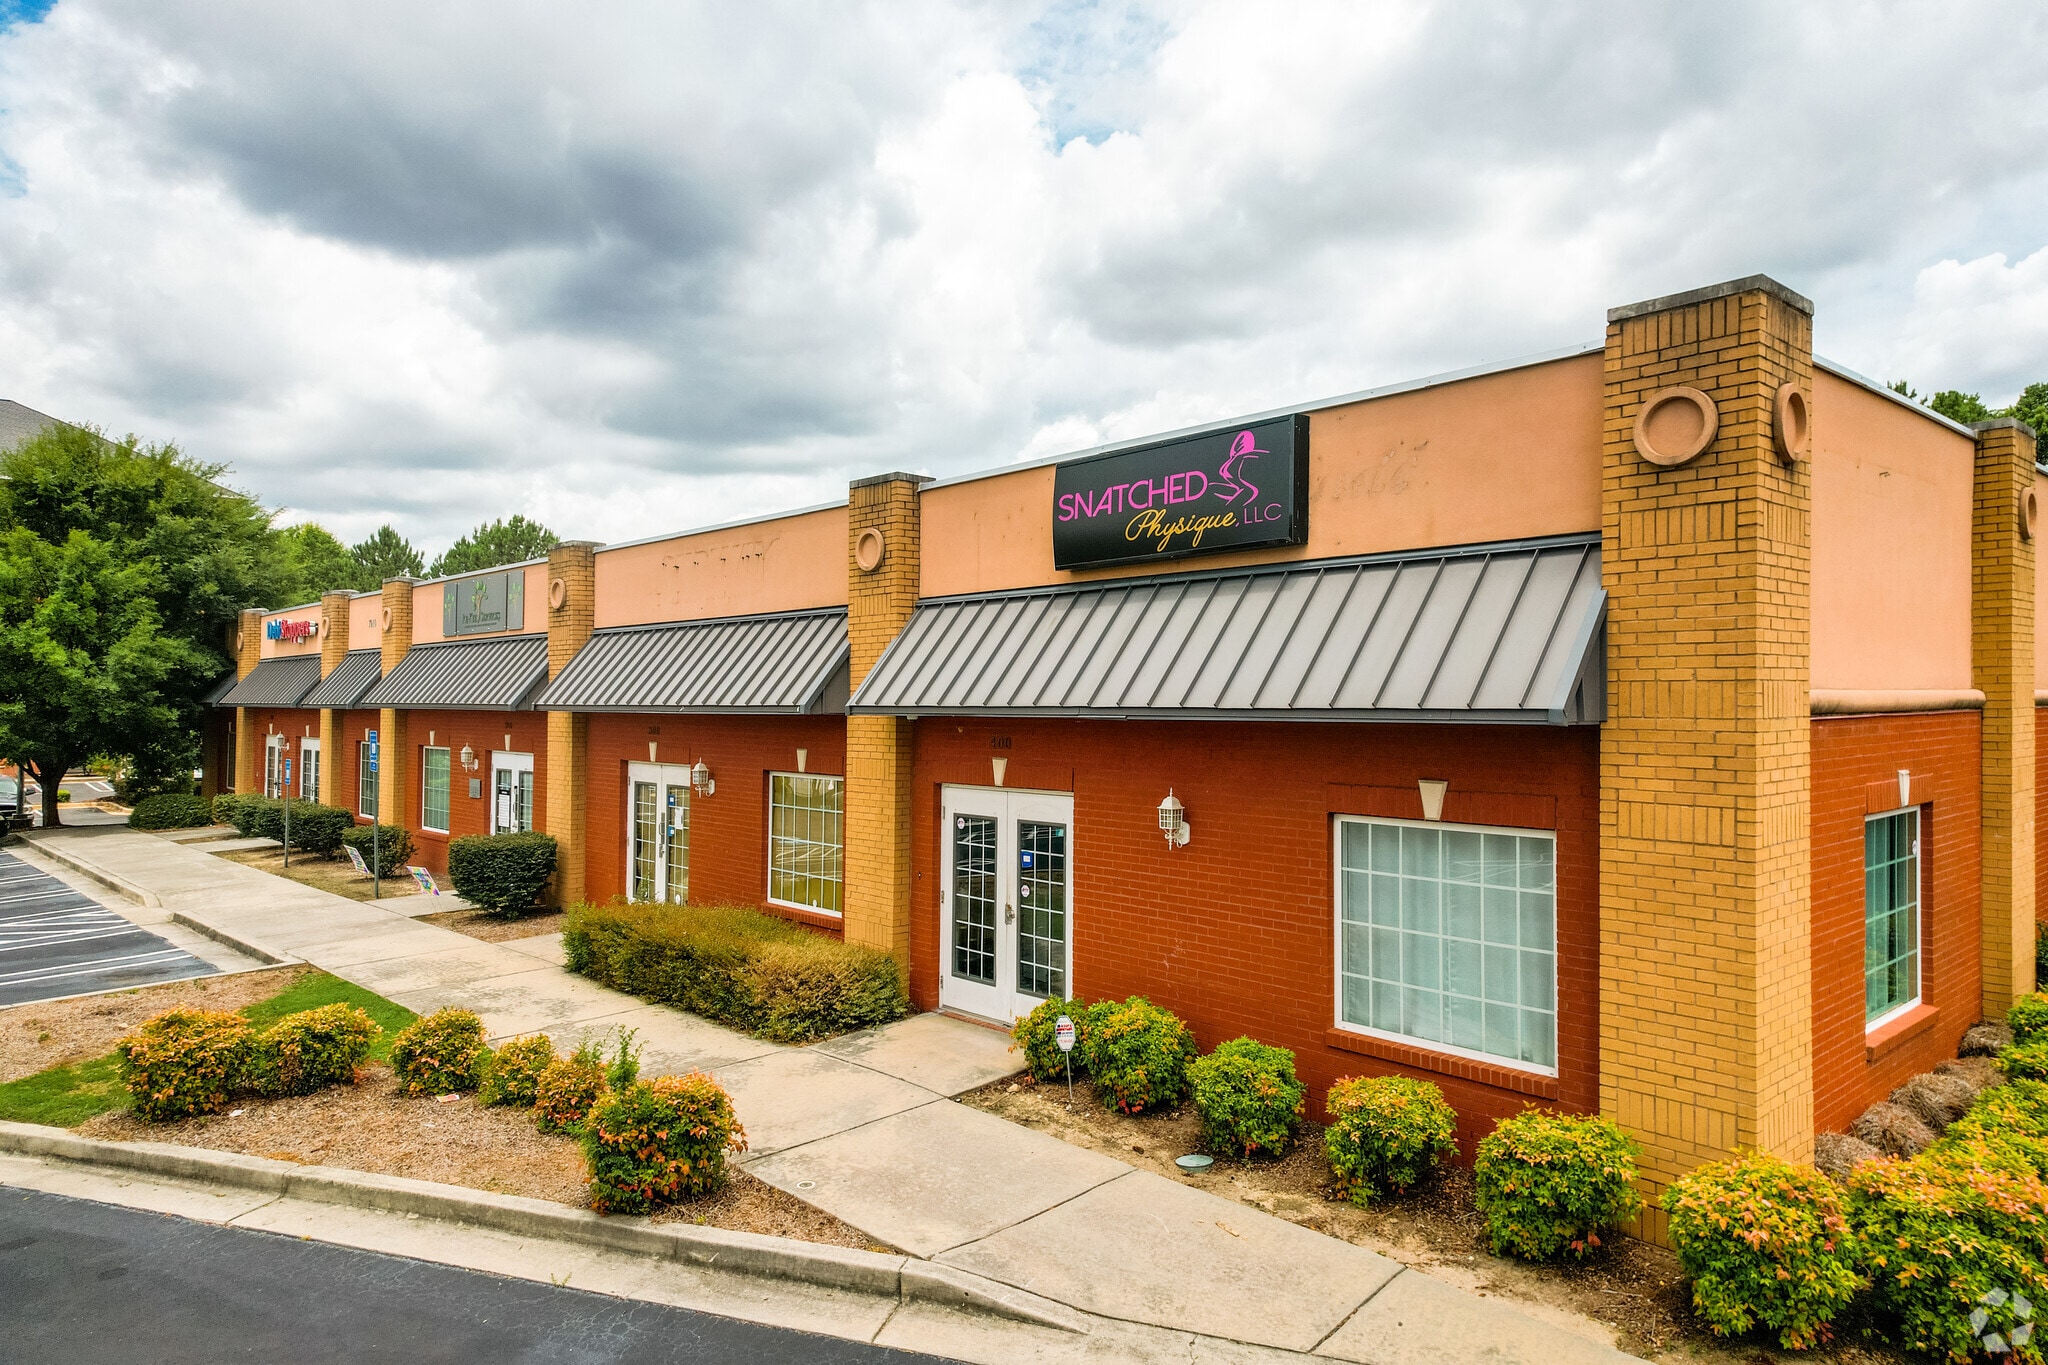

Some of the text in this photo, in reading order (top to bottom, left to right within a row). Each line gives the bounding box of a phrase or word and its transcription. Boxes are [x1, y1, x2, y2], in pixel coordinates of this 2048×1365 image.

[1058, 470, 1208, 521] SNATCHED
[1244, 503, 1282, 524] LLC
[991, 736, 1012, 749] 400
